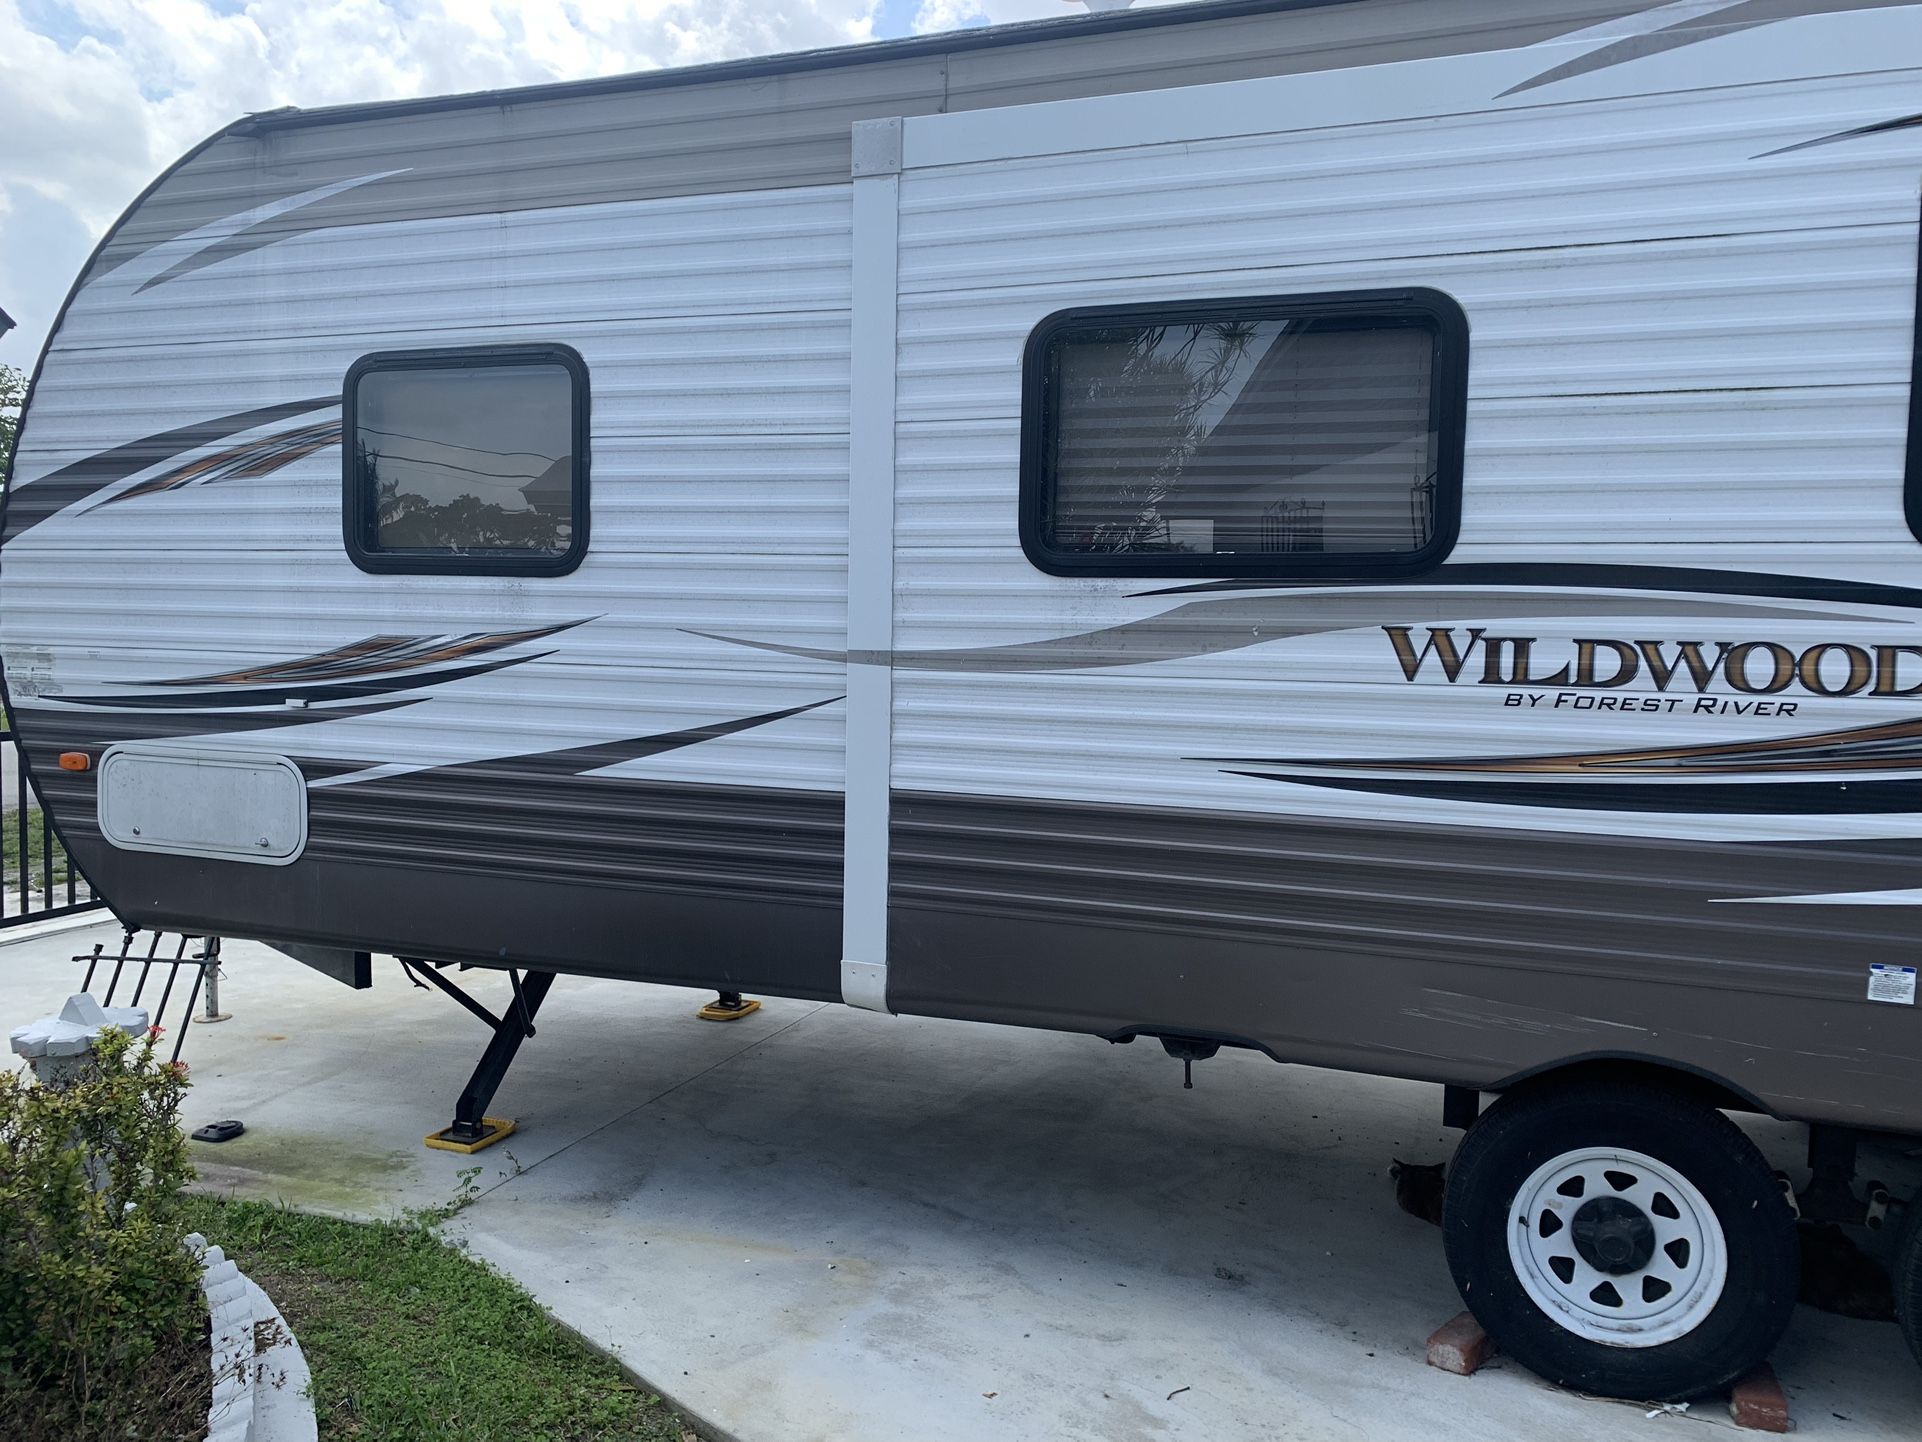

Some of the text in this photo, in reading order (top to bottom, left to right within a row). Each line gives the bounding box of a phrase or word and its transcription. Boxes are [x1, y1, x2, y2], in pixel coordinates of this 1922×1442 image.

[1382, 626, 1922, 697] WILDWOOD
[1504, 692, 1799, 717] BY FOREST RIVER
